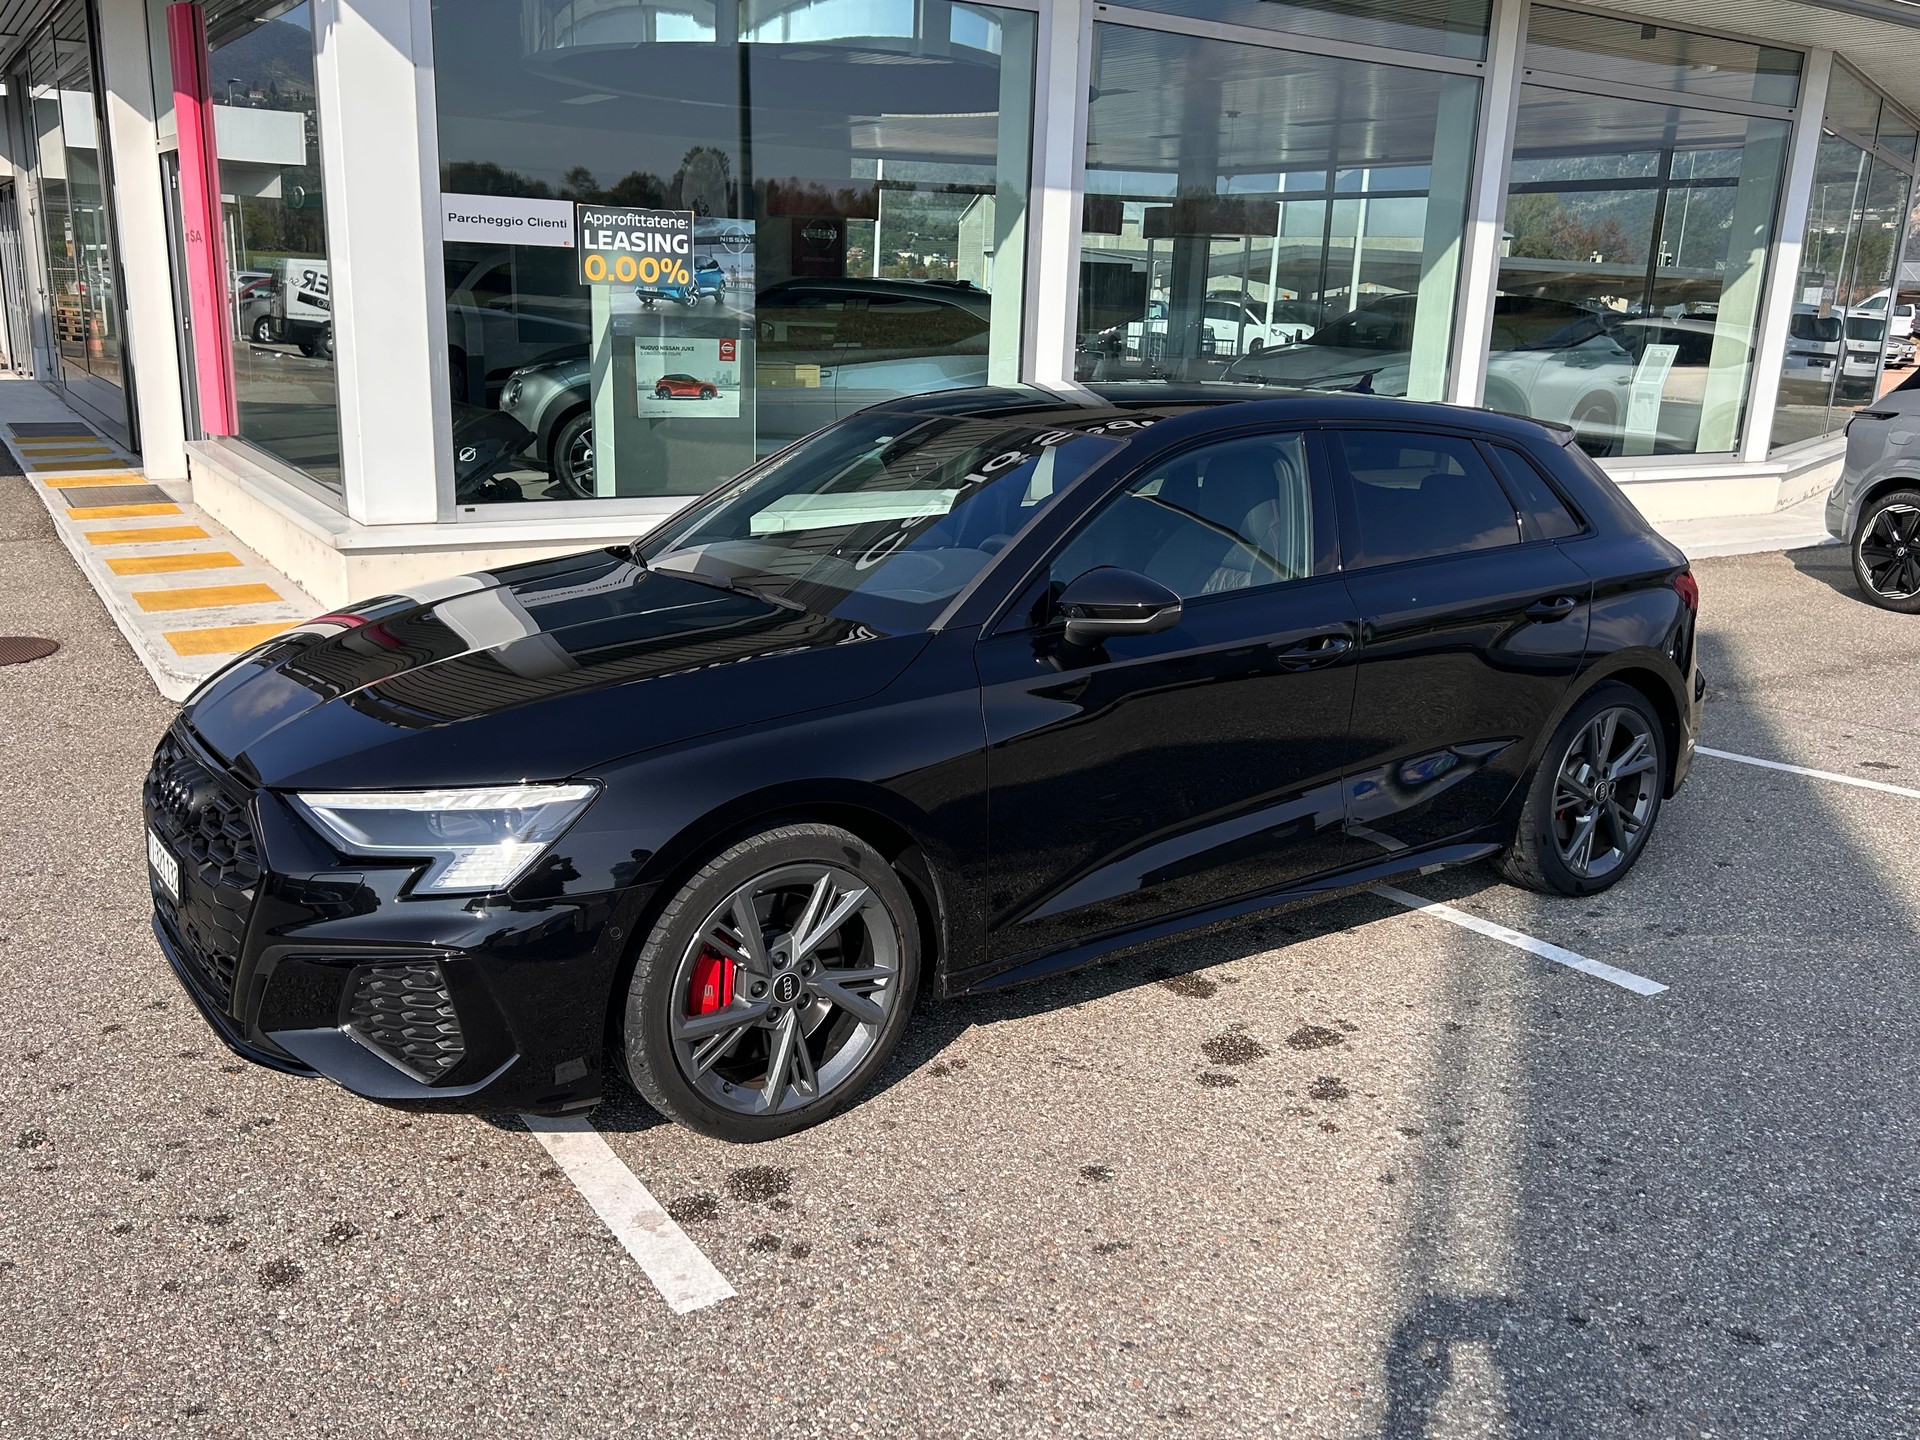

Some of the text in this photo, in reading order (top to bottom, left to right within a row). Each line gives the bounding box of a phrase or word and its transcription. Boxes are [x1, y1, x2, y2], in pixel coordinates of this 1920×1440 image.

[448, 212, 567, 229] Parcheggio Clienti
[583, 211, 689, 230] Approfittatene:
[584, 229, 689, 254] LEASING
[720, 236, 751, 244] NISSAN
[584, 254, 690, 285] 0.00%
